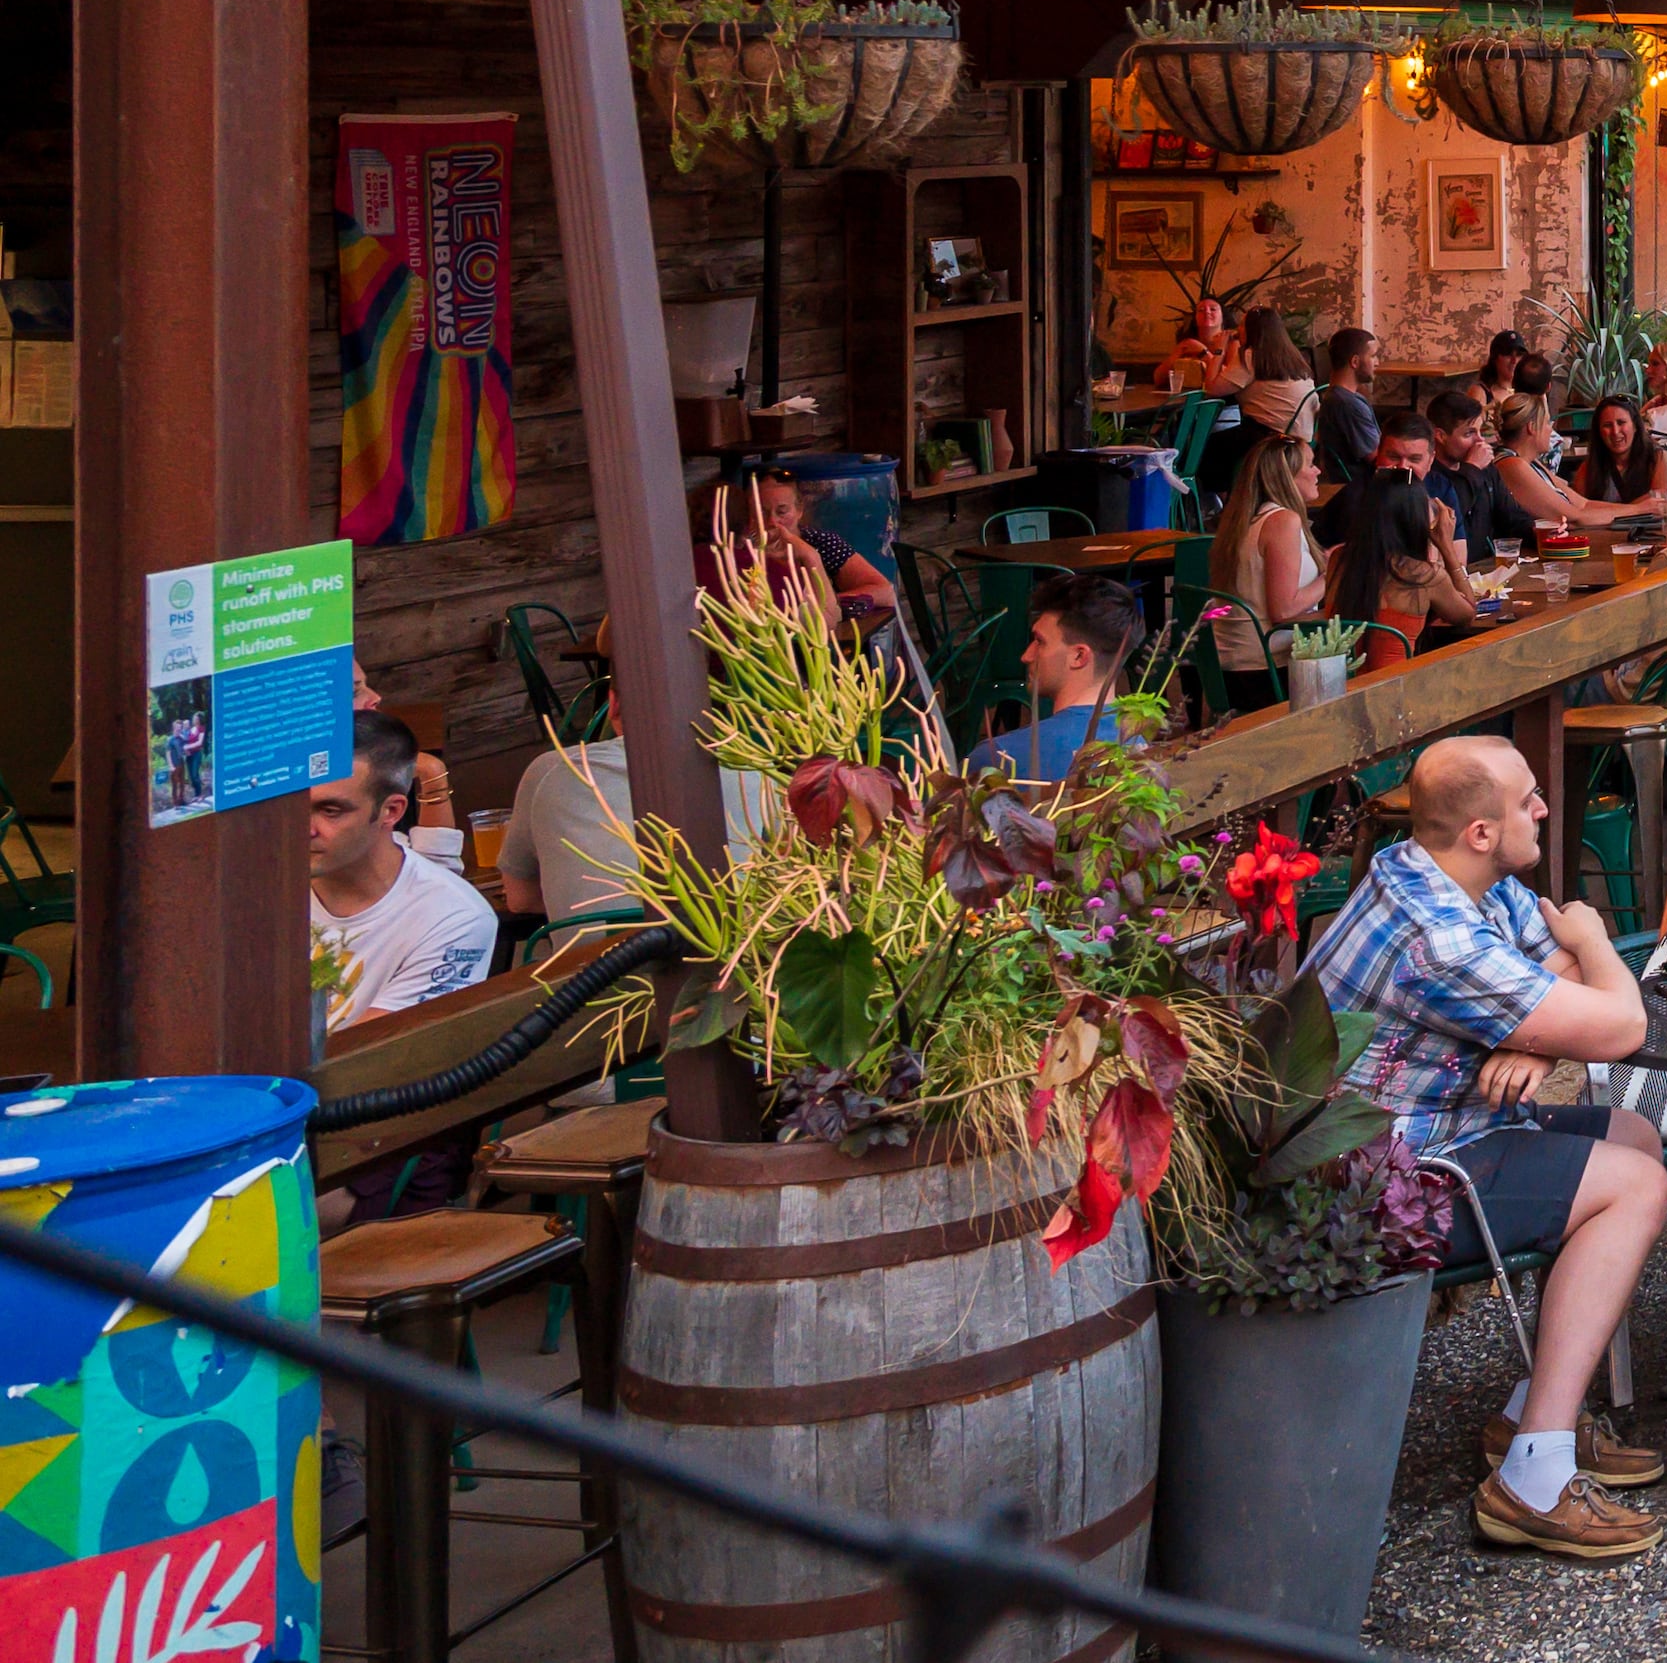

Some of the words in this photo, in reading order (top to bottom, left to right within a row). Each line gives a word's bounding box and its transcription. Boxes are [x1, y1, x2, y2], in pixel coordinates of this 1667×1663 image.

[404, 154, 418, 190] NEW
[430, 159, 456, 346] RAINBOWS
[452, 153, 503, 347] NEON
[222, 563, 295, 587] Minimize
[222, 586, 273, 611] runoff
[274, 580, 309, 601] with
[311, 574, 344, 594] PHS
[169, 610, 194, 626] PHS
[222, 607, 314, 636] stormwater
[223, 635, 298, 660] solutions.
